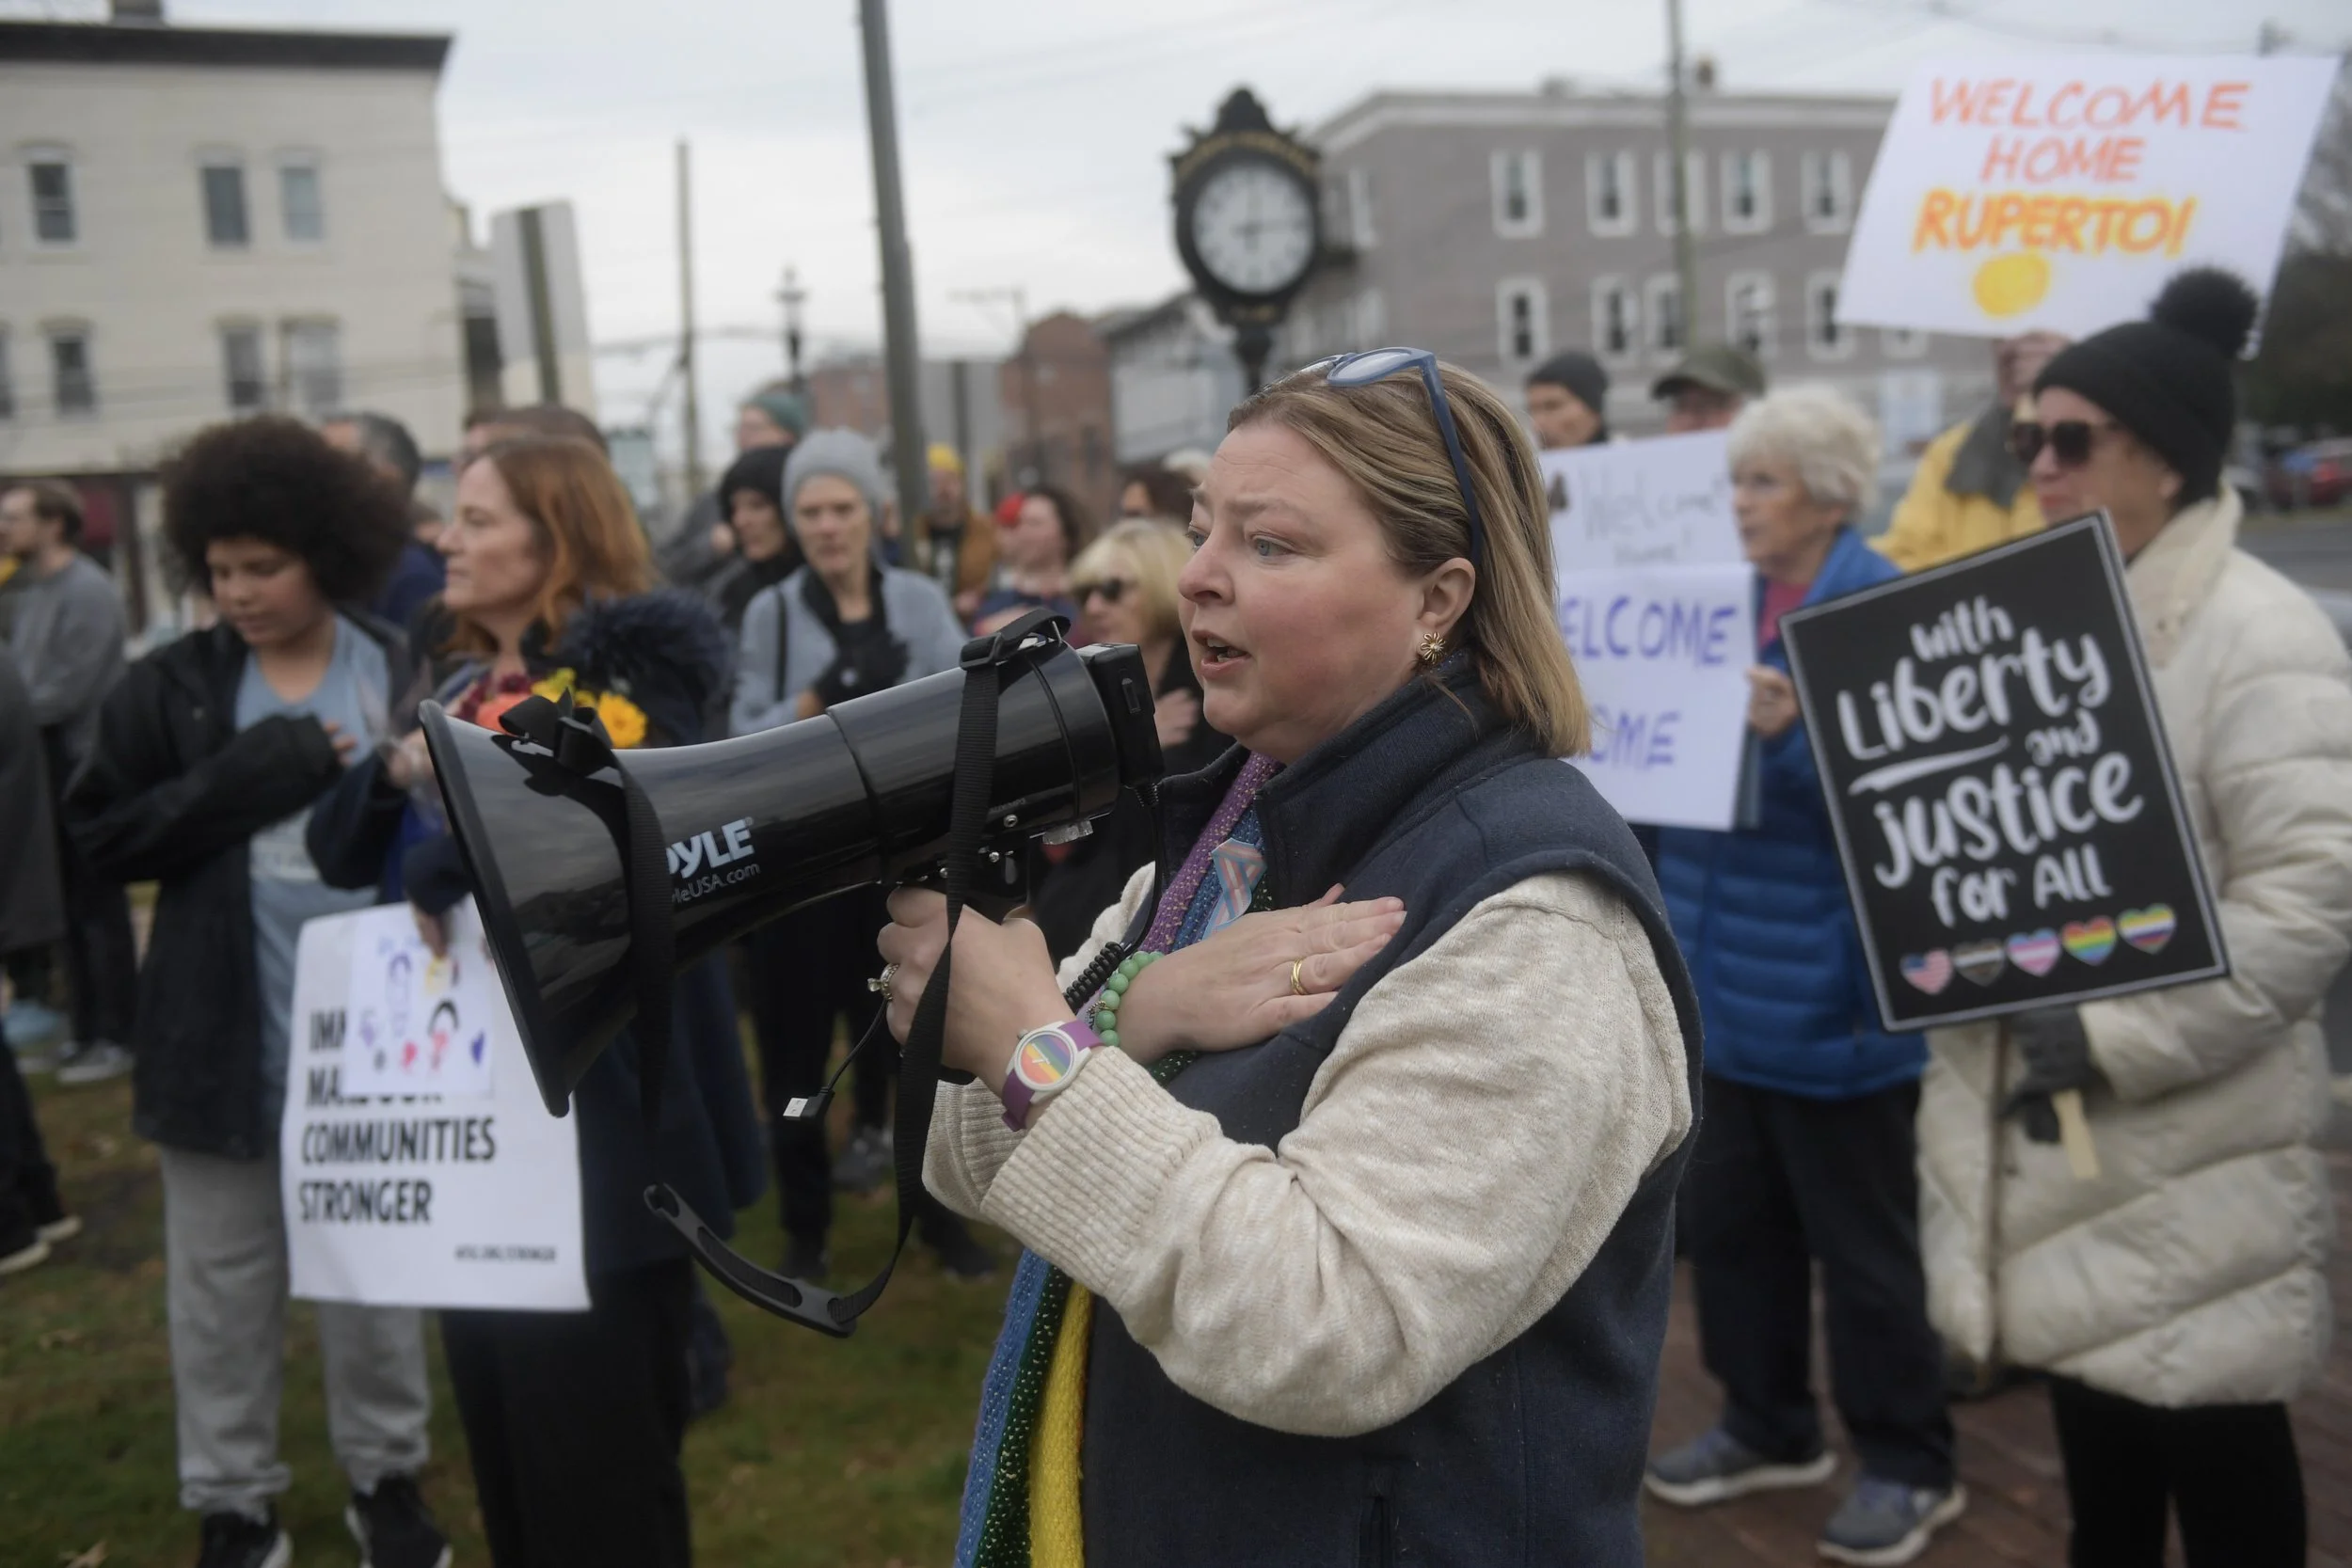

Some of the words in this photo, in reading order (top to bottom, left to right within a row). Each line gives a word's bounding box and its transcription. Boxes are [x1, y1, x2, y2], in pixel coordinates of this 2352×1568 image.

[1931, 78, 2252, 131] WELCOME
[1981, 136, 2144, 182] HOME
[1912, 189, 2198, 257] RUPERTO!
[1560, 594, 1738, 665] ELCOME
[1910, 595, 2014, 661] with
[1837, 627, 2111, 759] Liberty
[2026, 709, 2101, 766] and
[1590, 703, 1682, 769] OME
[1874, 752, 2144, 888] justice
[1931, 867, 2019, 927] for
[301, 1117, 496, 1166] COMMUNITIES
[298, 1179, 433, 1225] STRONGER
